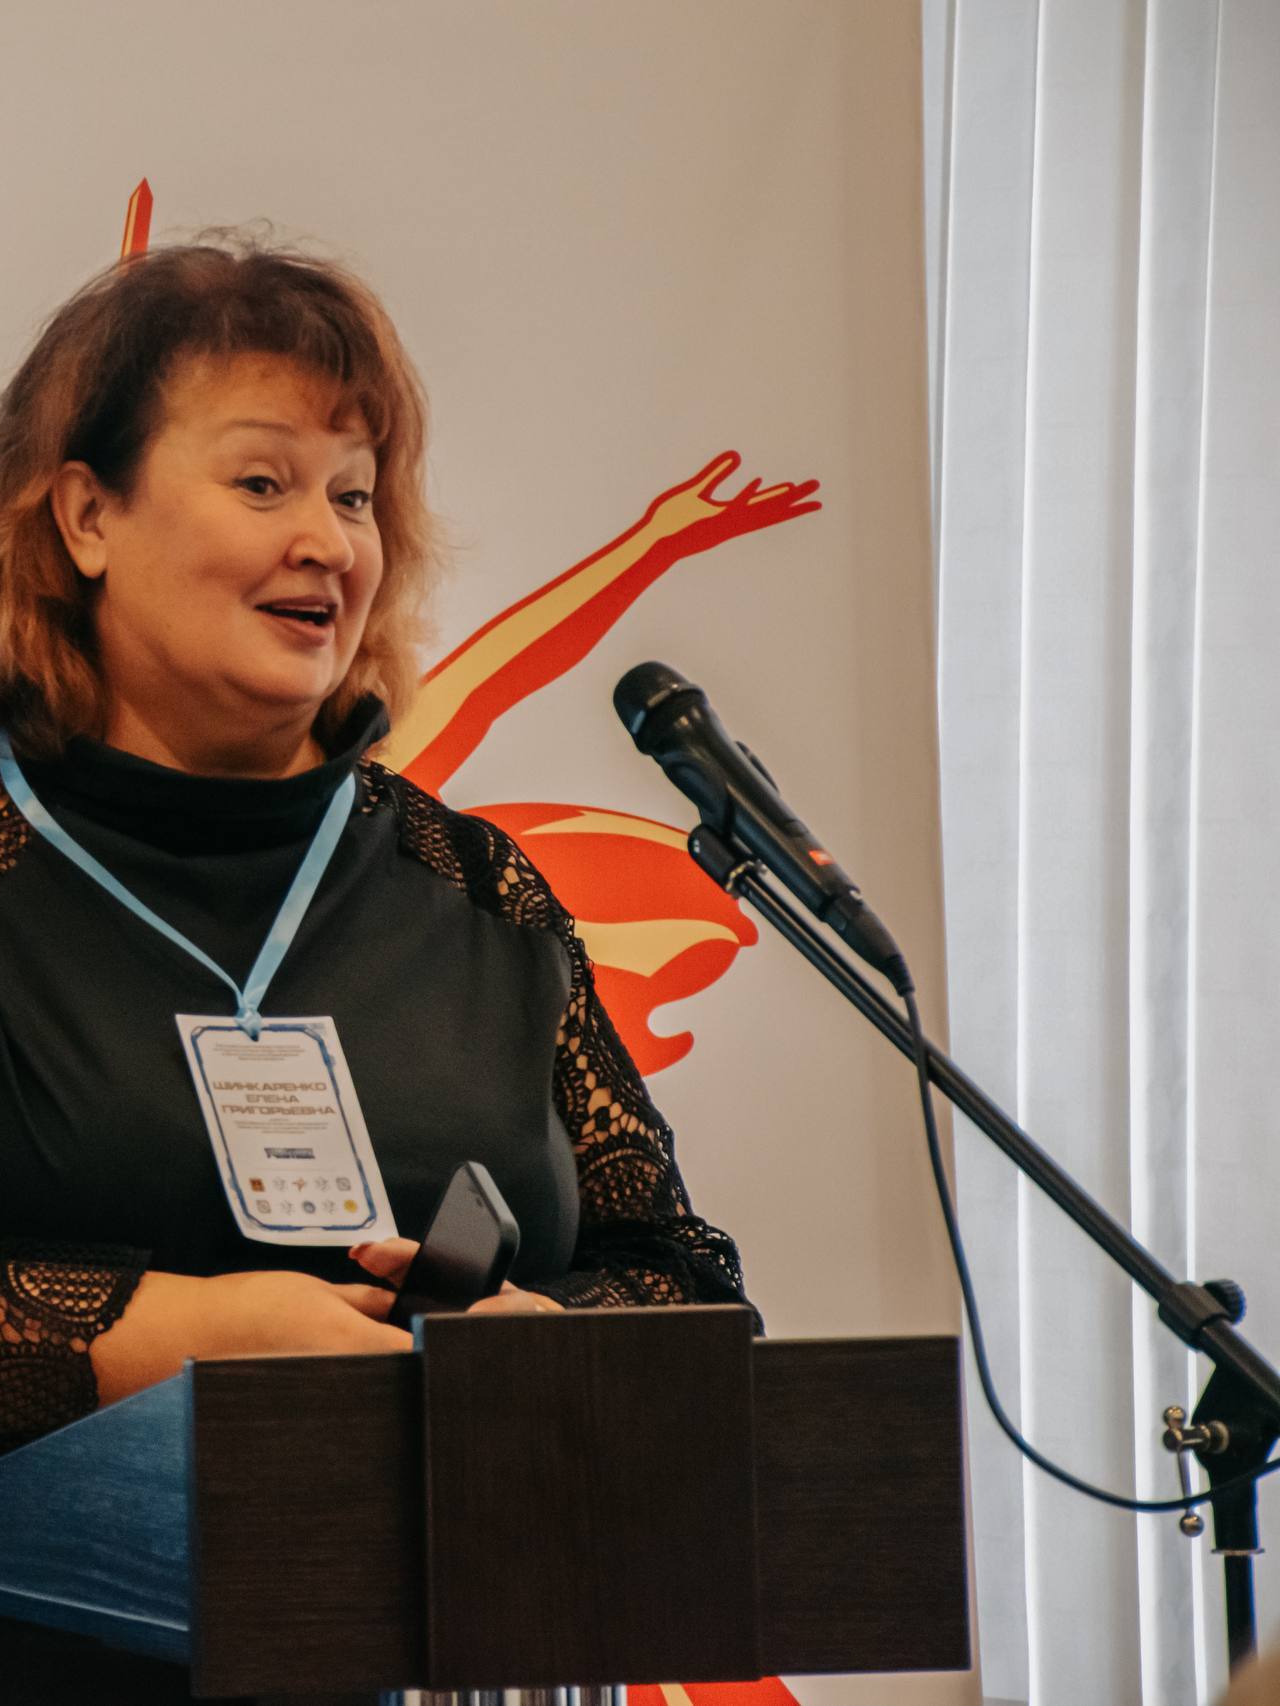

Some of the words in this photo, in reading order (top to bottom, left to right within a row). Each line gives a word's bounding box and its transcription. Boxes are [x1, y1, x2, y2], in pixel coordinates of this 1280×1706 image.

[212, 1082, 327, 1092] ШИНКАРЕНКО
[245, 1094, 300, 1103] ЕЛЕНА
[221, 1105, 336, 1116] ГРИГОРЬЕВНА
